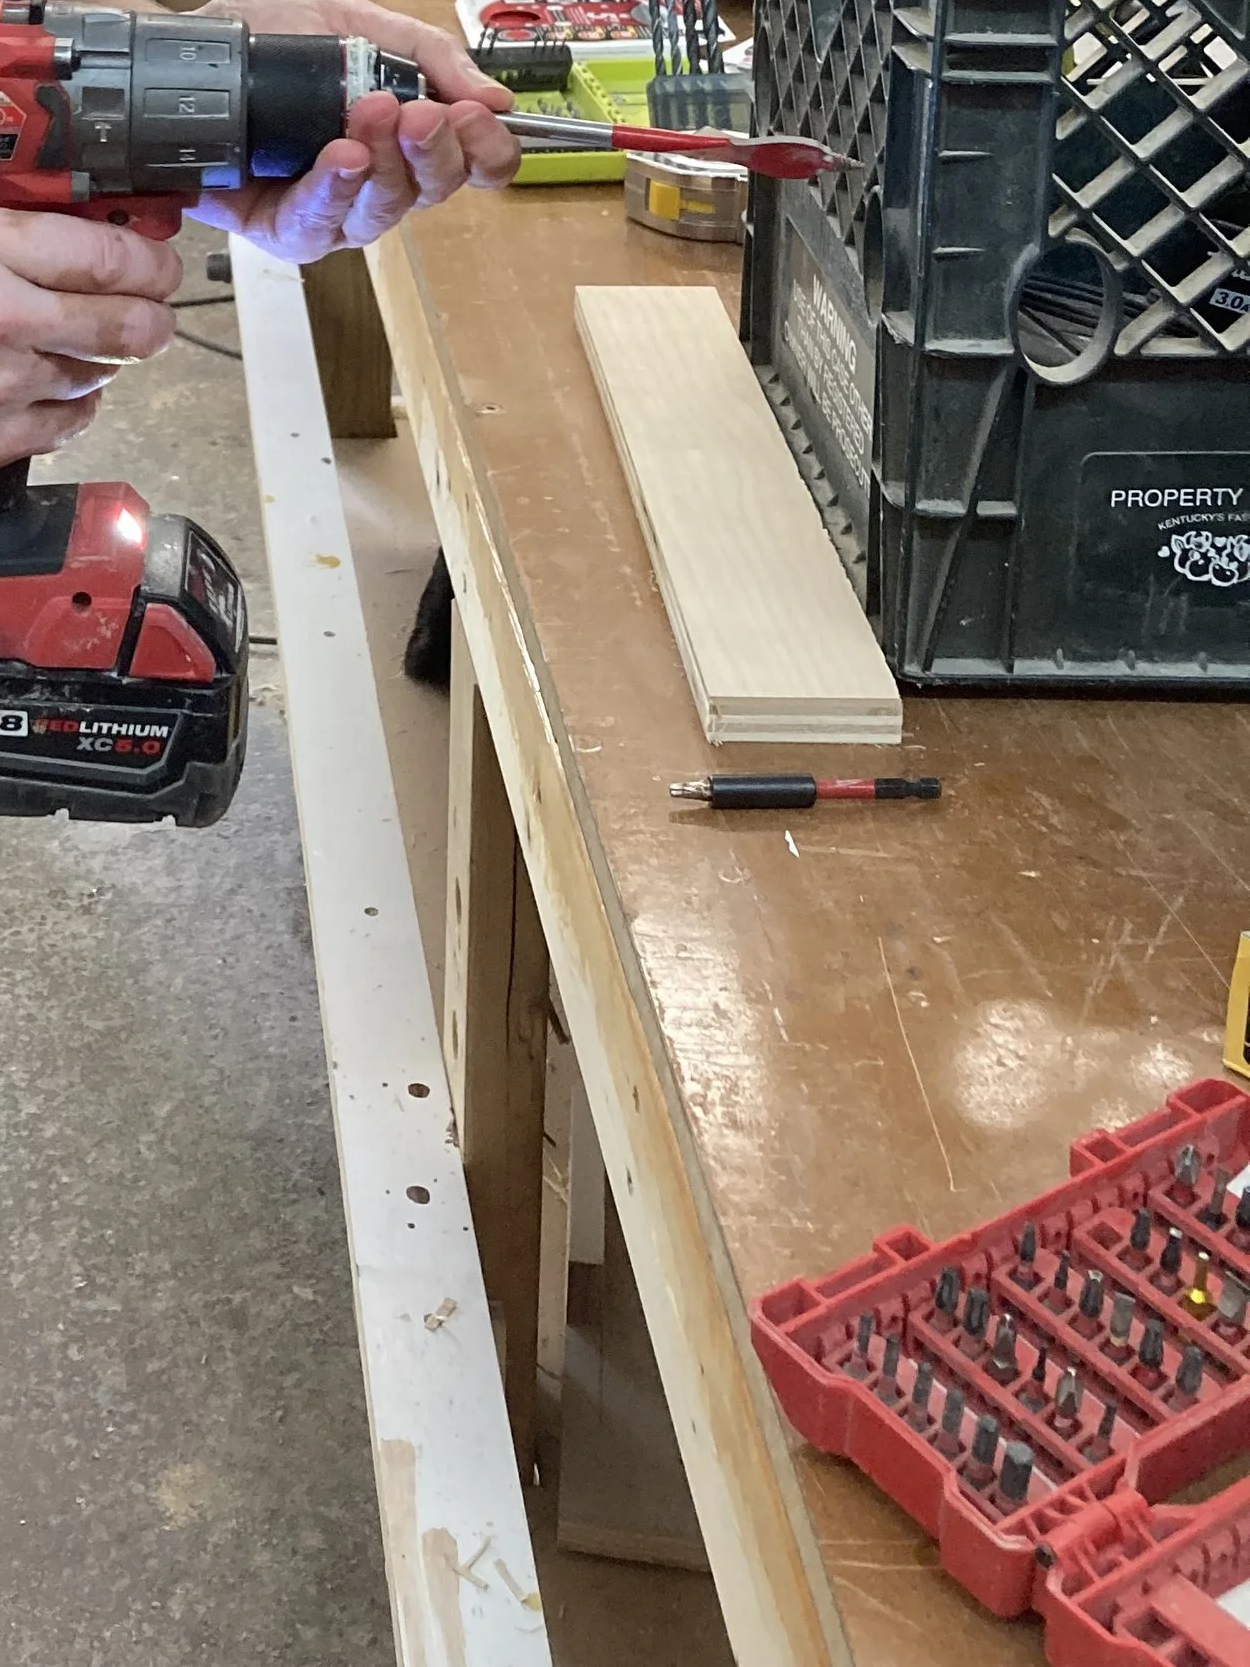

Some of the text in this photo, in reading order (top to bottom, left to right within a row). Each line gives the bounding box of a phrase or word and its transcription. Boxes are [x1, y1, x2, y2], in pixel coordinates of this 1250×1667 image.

[180, 45, 196, 61] 10
[178, 95, 195, 113] 12
[813, 271, 857, 378] WARNING
[1110, 487, 1244, 508] PROPERTY
